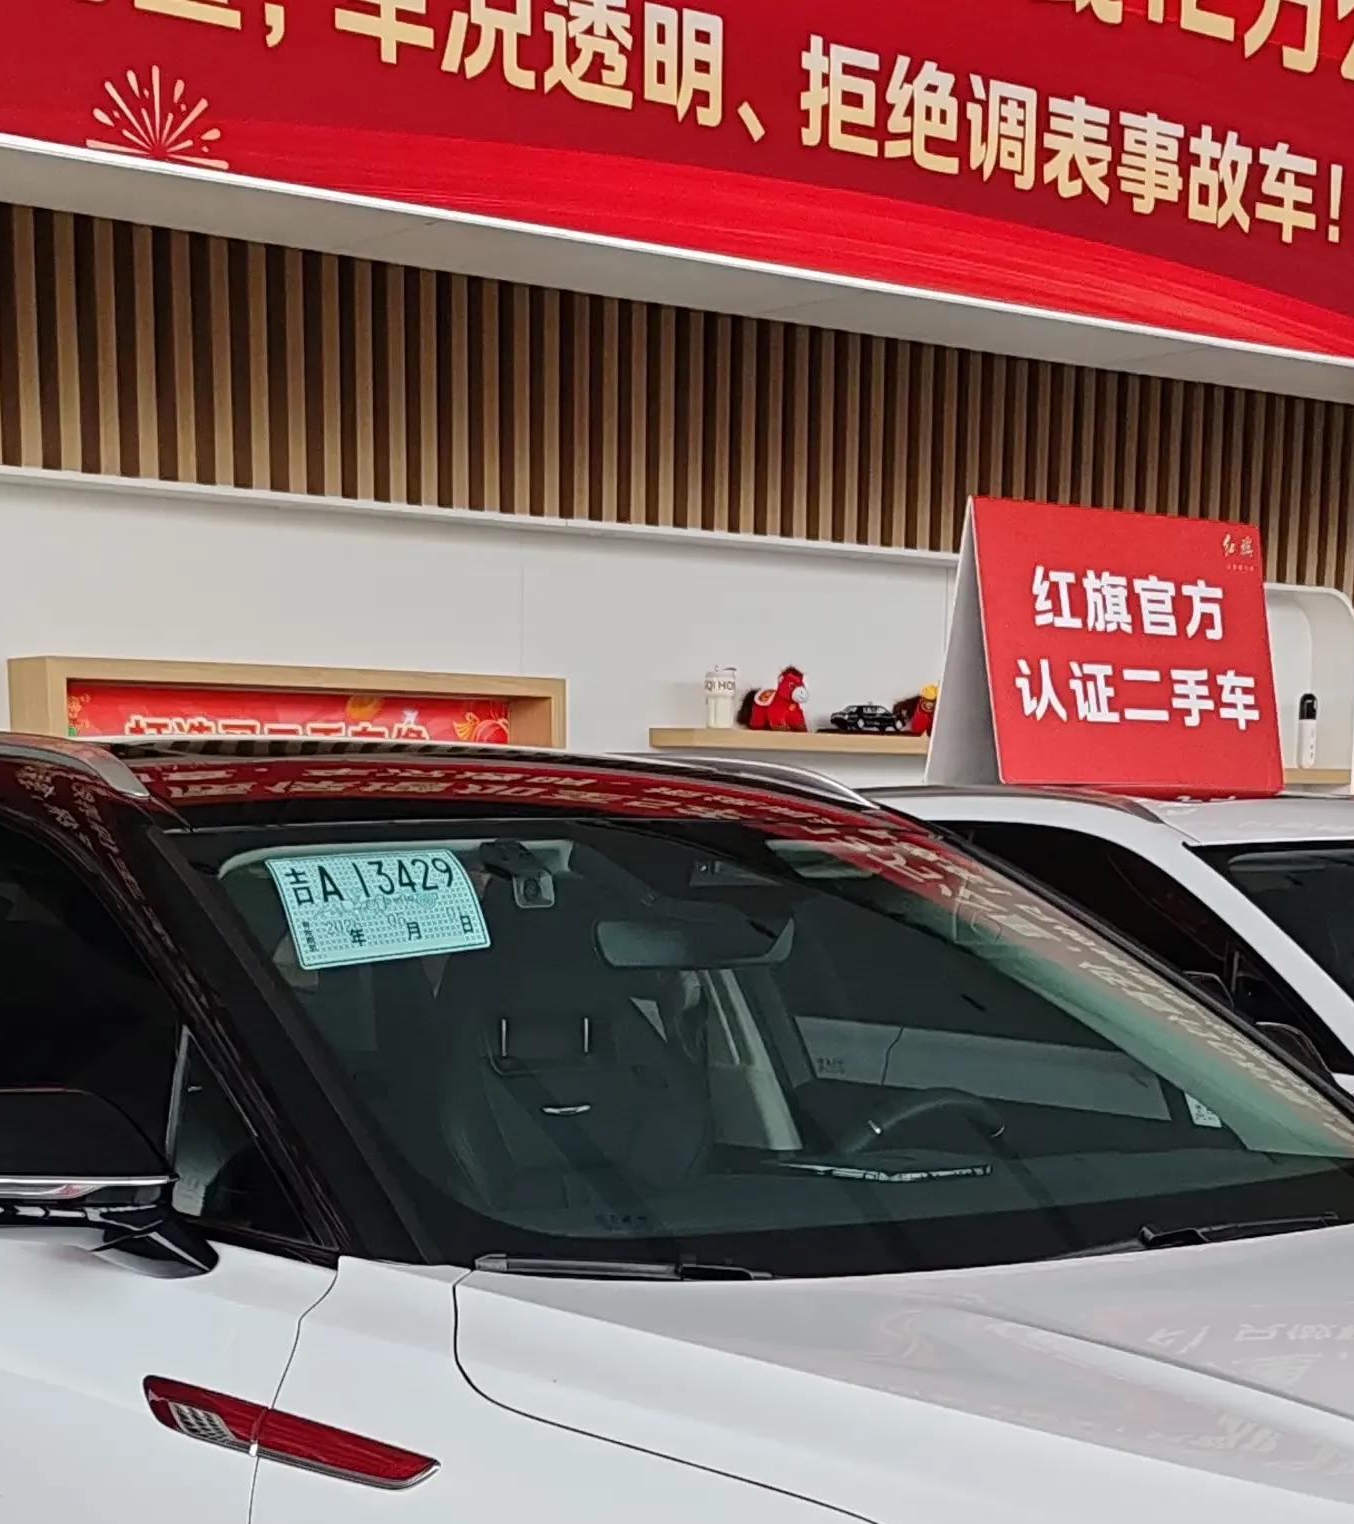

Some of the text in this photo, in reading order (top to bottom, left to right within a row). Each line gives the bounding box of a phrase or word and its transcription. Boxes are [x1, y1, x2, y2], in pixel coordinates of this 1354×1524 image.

[1032, 565, 1224, 640] 红旗官方
[1015, 658, 1262, 731] 认证二手车
[284, 857, 454, 906] 吉A13429
